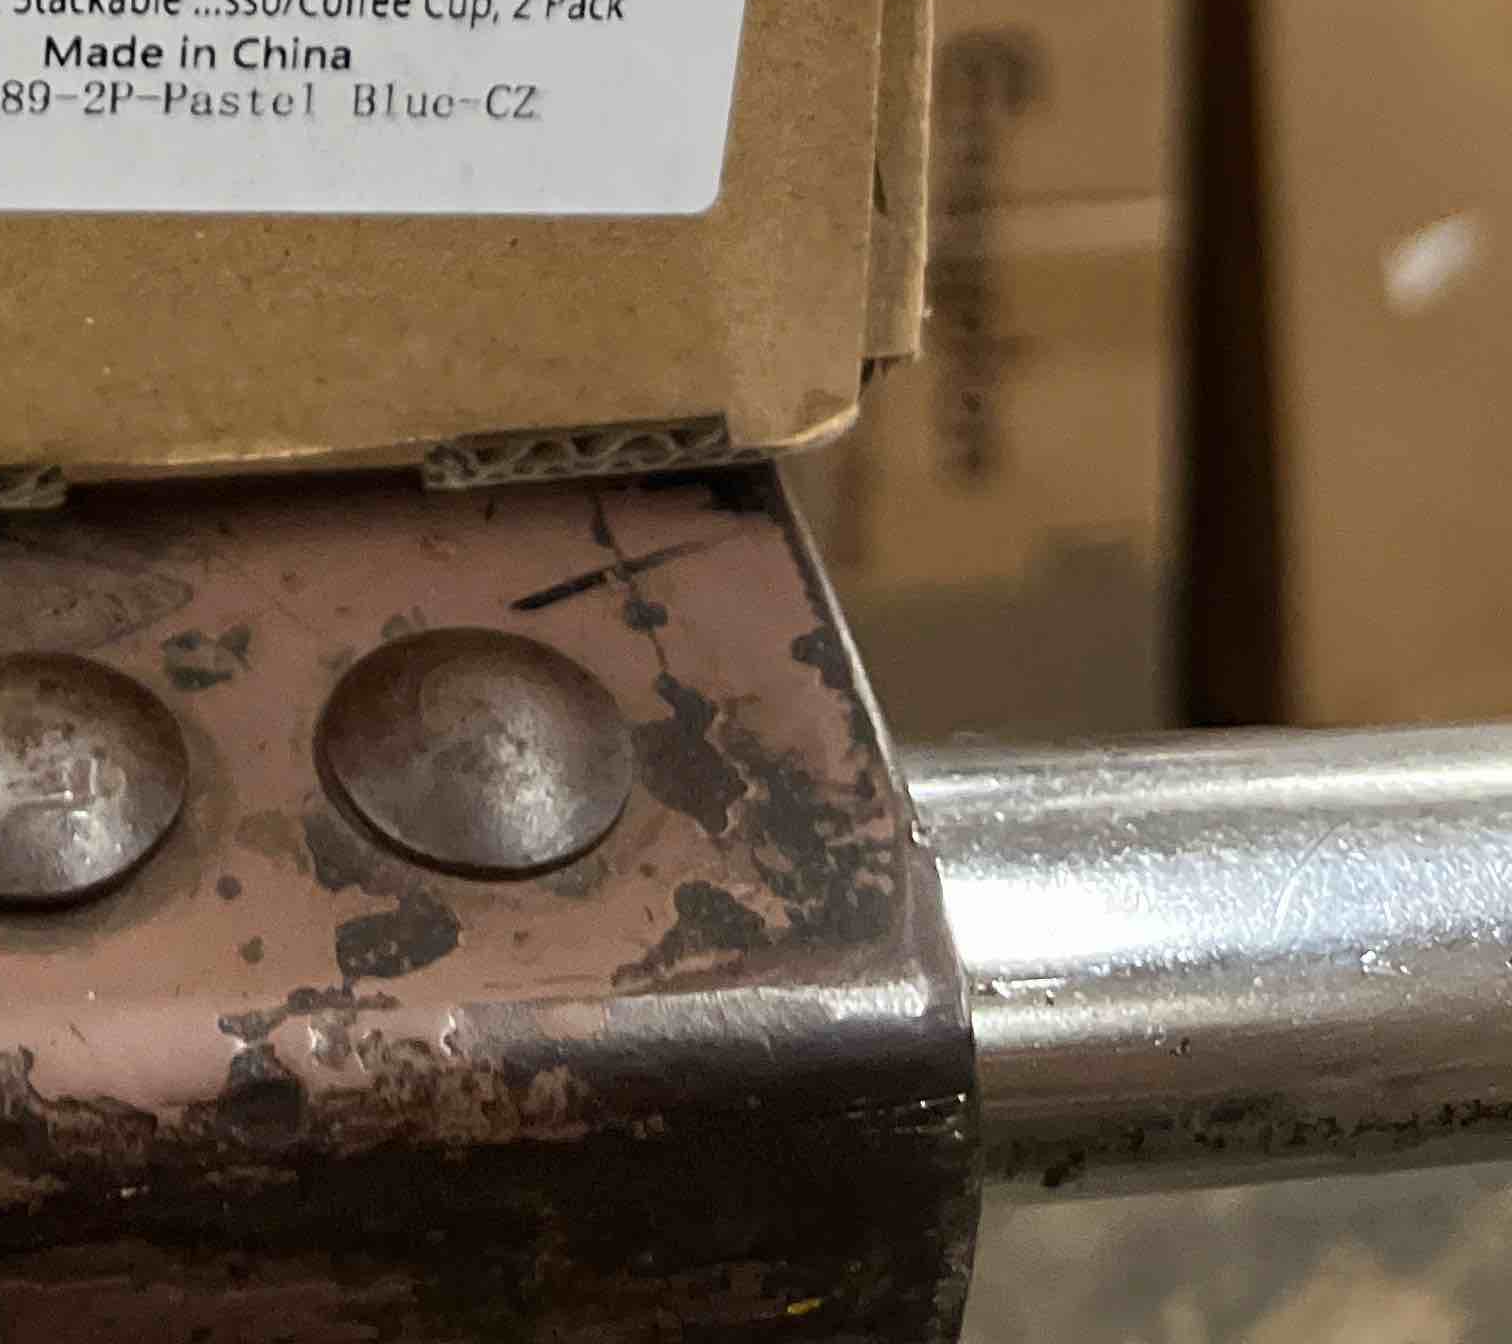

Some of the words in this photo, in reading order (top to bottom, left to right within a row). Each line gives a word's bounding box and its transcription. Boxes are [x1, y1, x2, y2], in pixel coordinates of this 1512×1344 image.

[43, 35, 164, 69] Made
[180, 34, 217, 69] in
[233, 35, 352, 71] China
